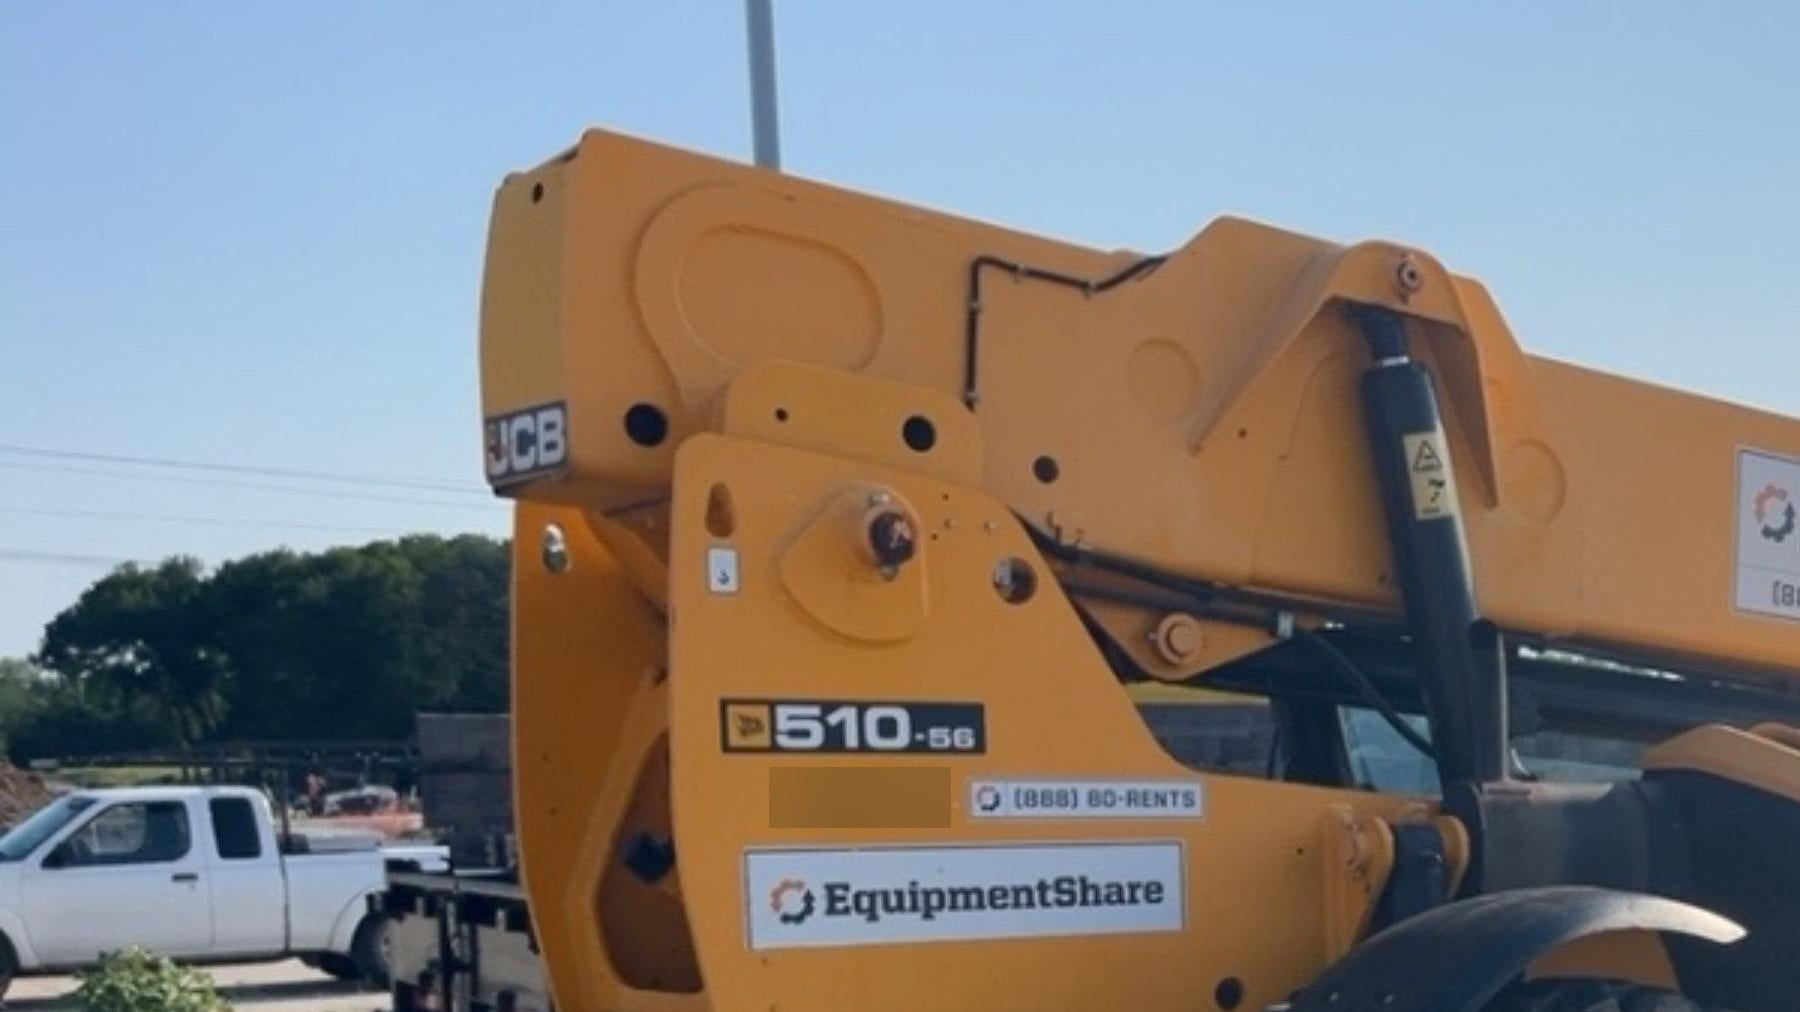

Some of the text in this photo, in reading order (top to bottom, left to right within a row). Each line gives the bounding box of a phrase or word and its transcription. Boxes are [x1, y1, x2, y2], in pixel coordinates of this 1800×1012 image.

[487, 408, 565, 475] JCB
[774, 703, 976, 749] 510-56
[822, 874, 1165, 922] EquipmentShare
